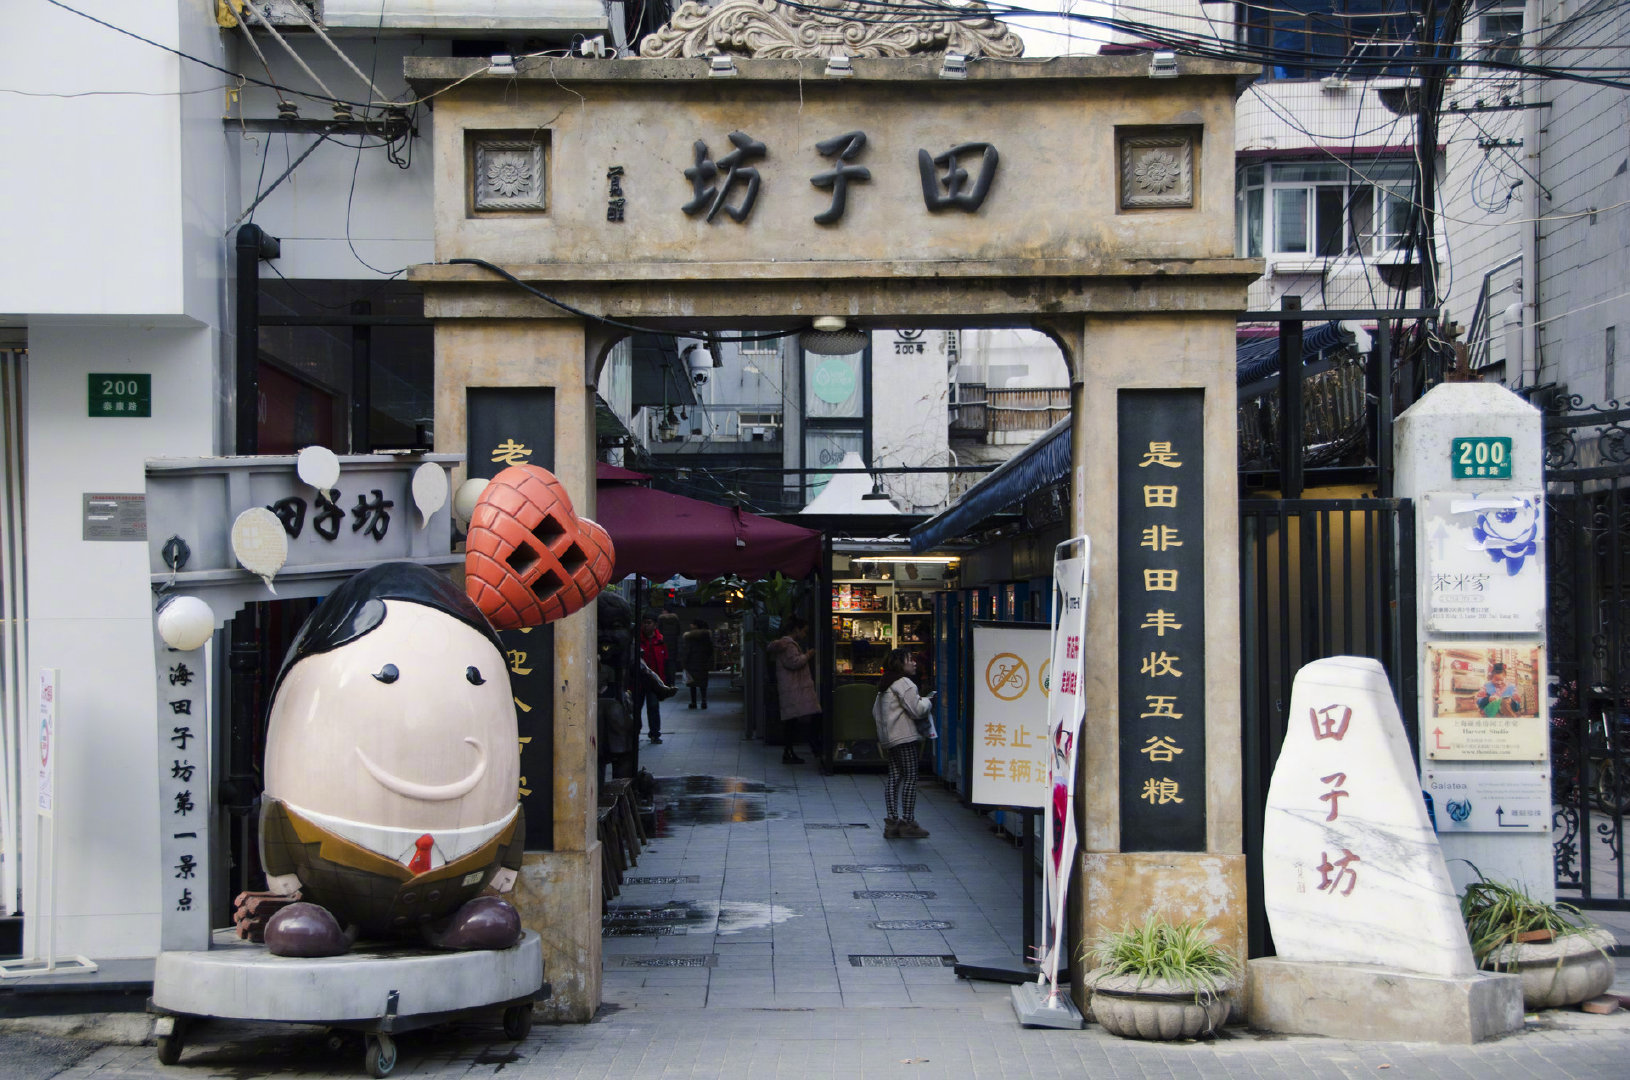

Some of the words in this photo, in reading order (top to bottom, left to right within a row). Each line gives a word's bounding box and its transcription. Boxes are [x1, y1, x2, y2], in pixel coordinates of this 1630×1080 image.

[682, 130, 999, 224] 田子坊
[102, 380, 138, 396] 200
[102, 401, 138, 412] 泰康路
[1459, 442, 1503, 465] 200
[1464, 466, 1499, 476] 泰康路
[266, 488, 394, 542] 田子坊
[1431, 573, 1490, 592] 茶米家
[1138, 440, 1185, 805] 是田非田丰收五谷粮
[167, 648, 198, 911] 海田子坊第一景点
[1431, 782, 1467, 790] Galatea
[1309, 703, 1361, 897] 田子坊
